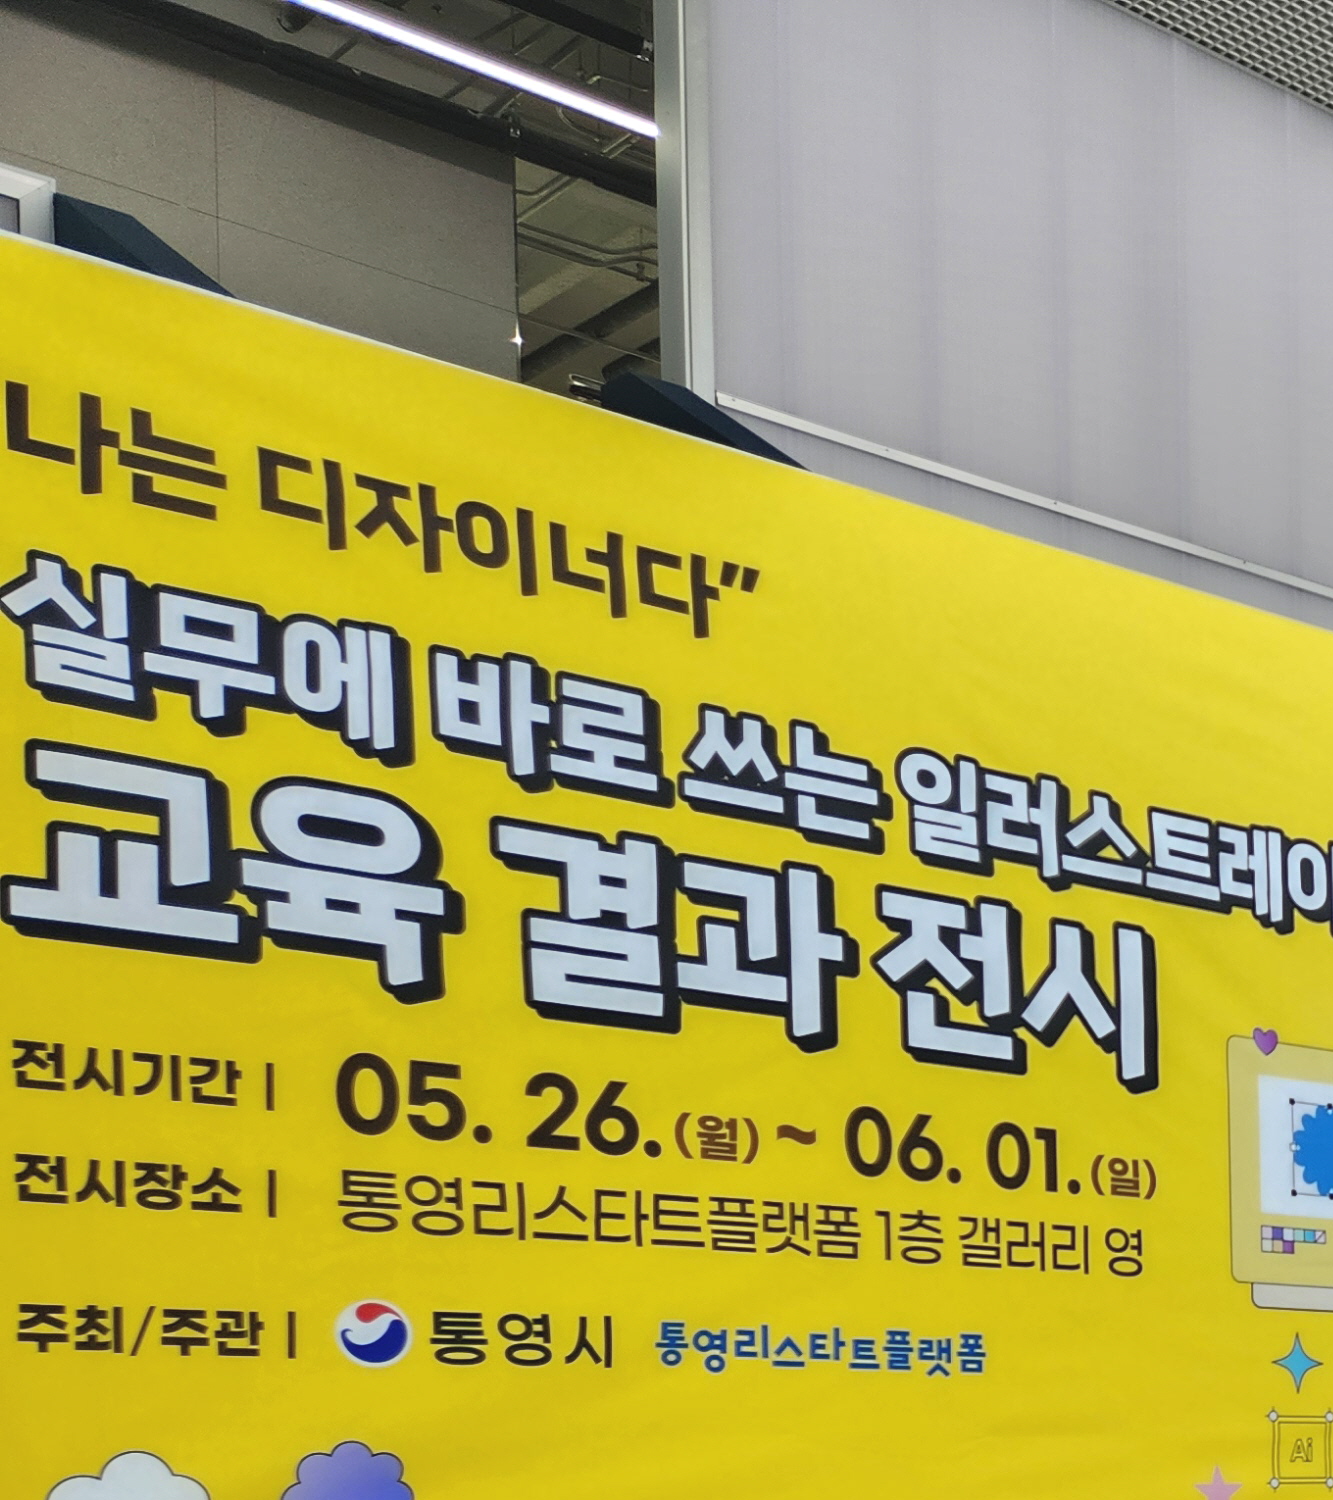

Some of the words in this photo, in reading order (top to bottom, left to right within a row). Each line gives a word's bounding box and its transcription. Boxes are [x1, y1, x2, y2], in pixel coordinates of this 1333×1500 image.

[5, 380, 227, 521] 나는
[0, 550, 411, 766] 실무에
[429, 644, 673, 807] 바로
[678, 703, 893, 854] 쓰는
[0, 737, 465, 1004] 교육
[489, 816, 860, 1053] 결과
[872, 884, 1158, 1094] 전시
[11, 1039, 242, 1107] 전시기간
[334, 1052, 494, 1145] 05.
[844, 1106, 963, 1185] 06.
[12, 1153, 243, 1214] 전시장소
[337, 1168, 861, 1260] 통영리스타트플랫폼
[877, 1209, 945, 1266] 1층
[958, 1214, 1092, 1277] 갤러리
[1103, 1227, 1145, 1278] 영
[15, 1302, 265, 1359] 주최/주관
[429, 1309, 616, 1368] 통영시
[655, 1319, 988, 1378] 통영리스타트플랫폼
[1289, 1437, 1313, 1463] Ai
